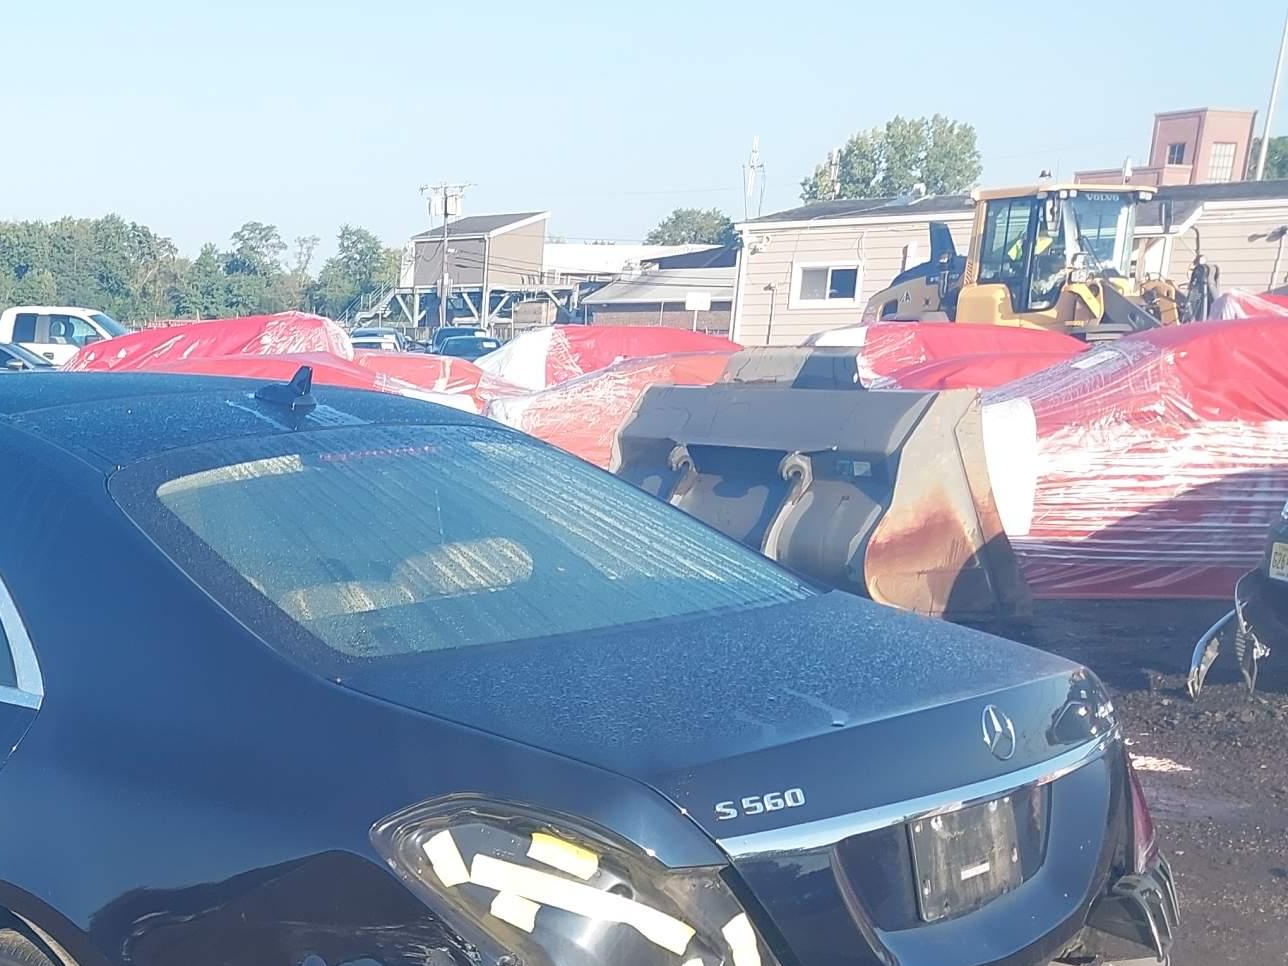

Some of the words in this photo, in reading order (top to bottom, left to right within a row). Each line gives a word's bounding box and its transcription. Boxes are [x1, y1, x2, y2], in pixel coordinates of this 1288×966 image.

[1085, 193, 1120, 202] VOLVO
[715, 801, 738, 820] S
[741, 787, 806, 815] 560
